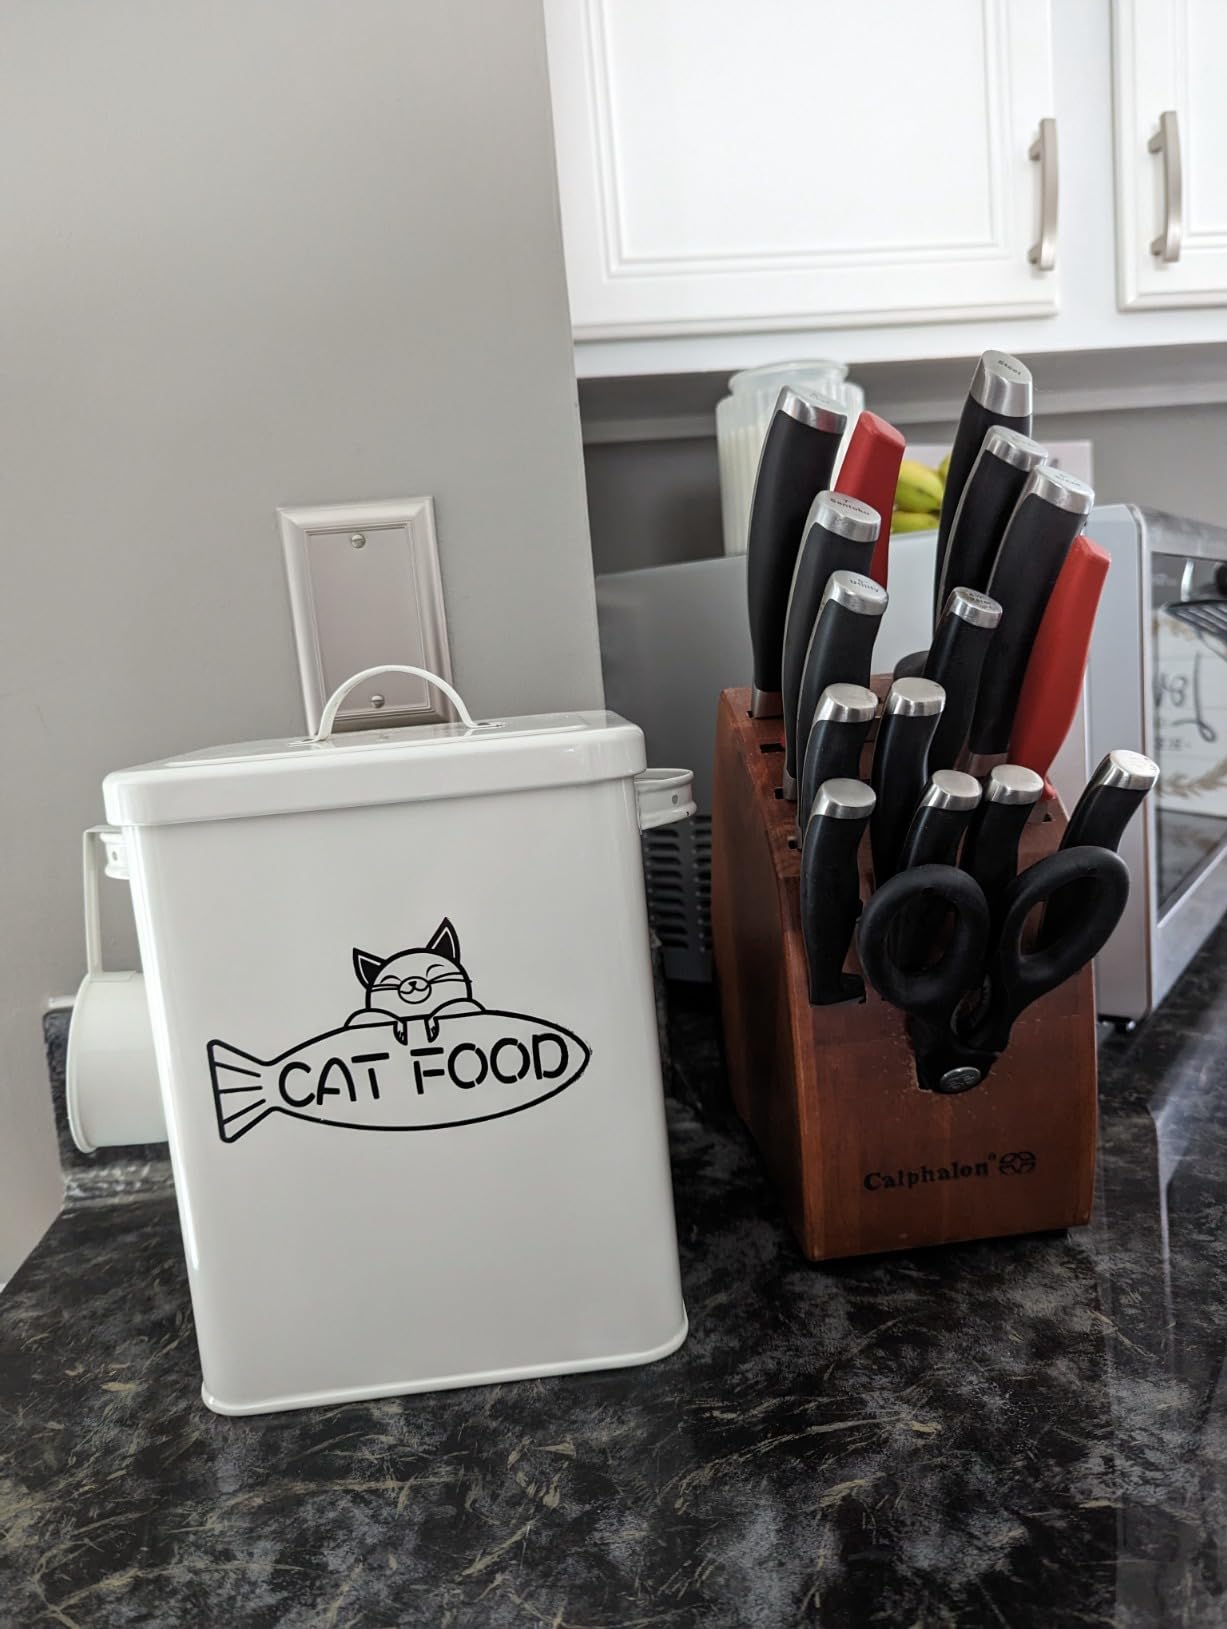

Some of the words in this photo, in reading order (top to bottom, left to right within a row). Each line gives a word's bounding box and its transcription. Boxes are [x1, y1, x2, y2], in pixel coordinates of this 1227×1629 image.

[278, 1051, 390, 1108] CAT
[410, 1033, 569, 1095] FOOD
[863, 1161, 989, 1192] Calphalon
